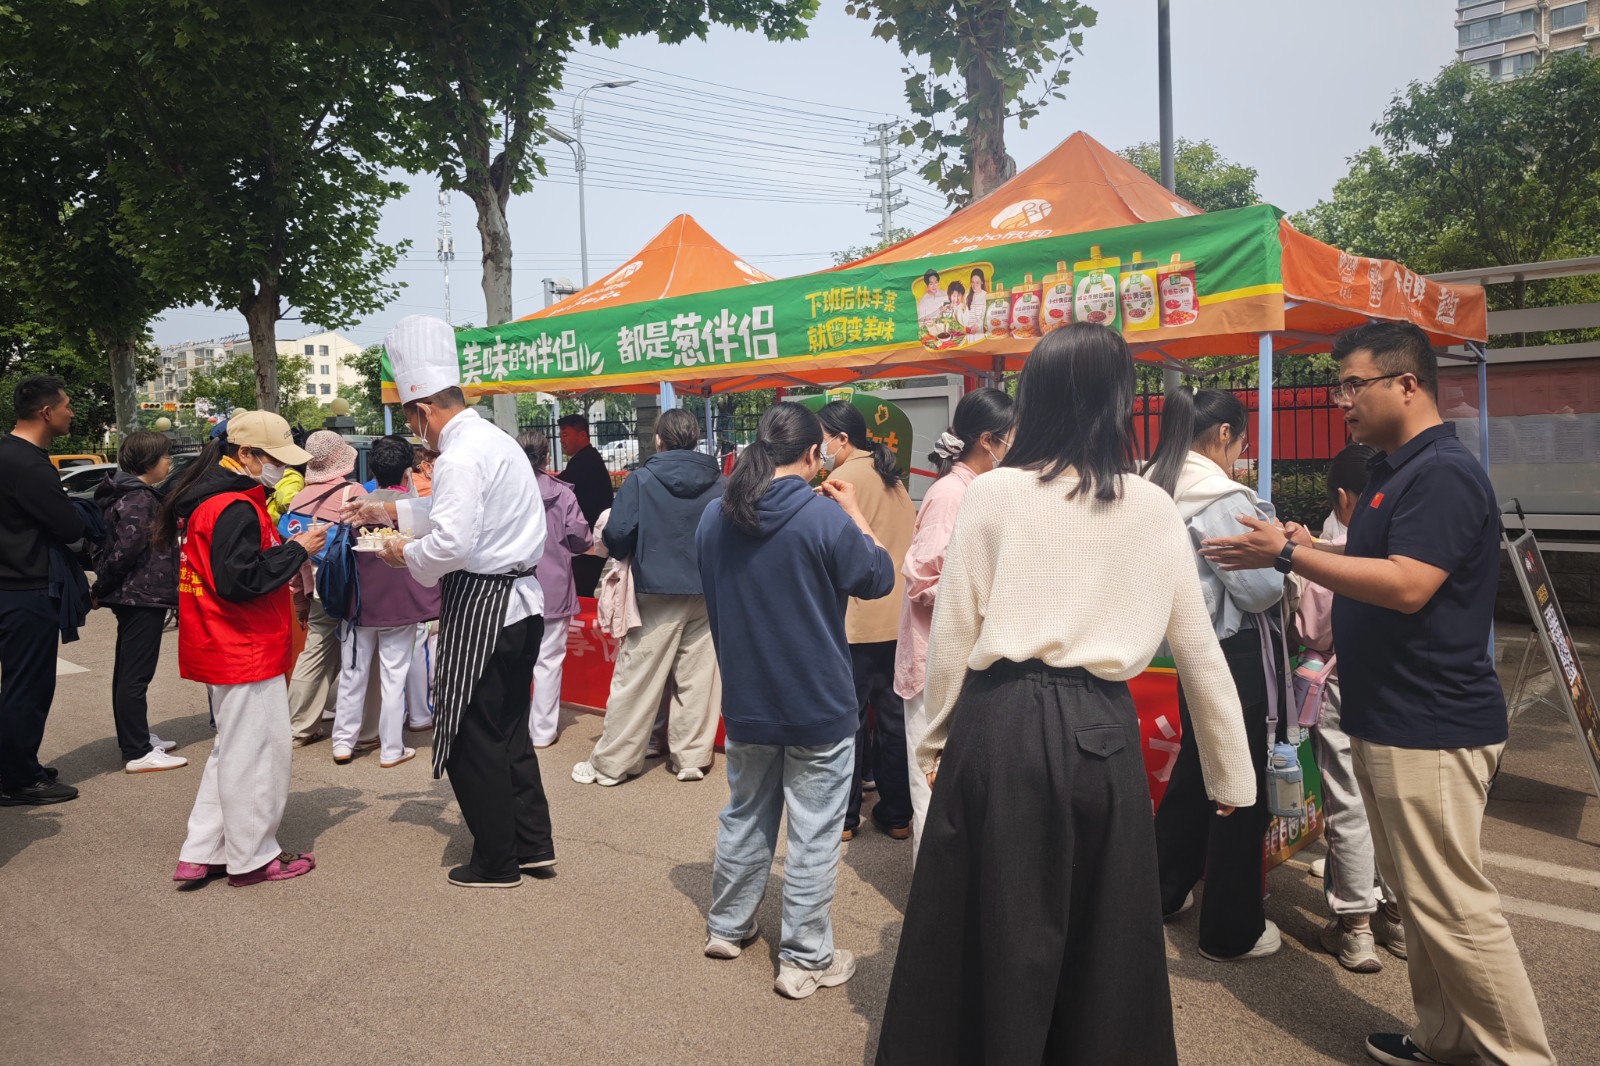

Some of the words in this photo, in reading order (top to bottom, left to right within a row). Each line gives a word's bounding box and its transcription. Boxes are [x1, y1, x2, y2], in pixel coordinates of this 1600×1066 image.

[805, 286, 897, 319] 下班后快手菜
[463, 329, 578, 387] 美味的伴侣
[617, 305, 778, 366] 都是葱伴侣
[807, 316, 896, 353] 就酱变美味
